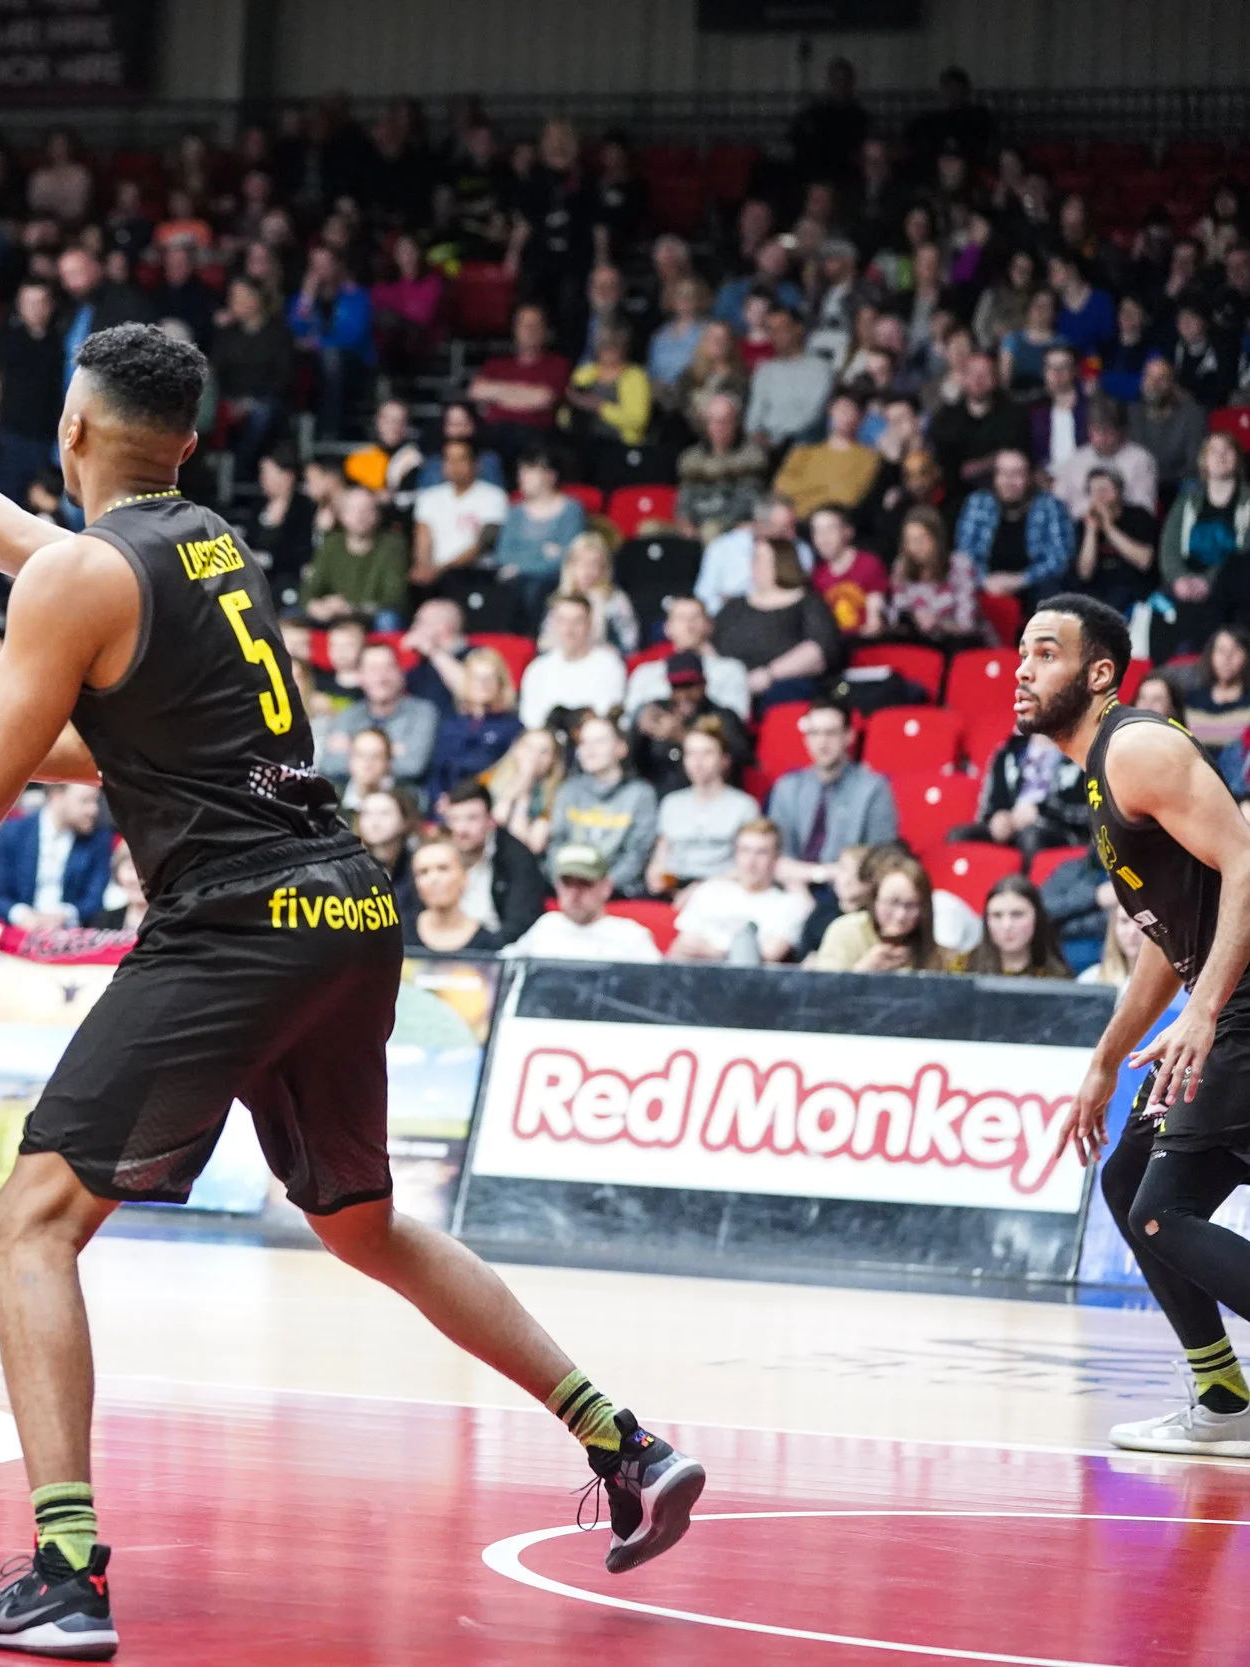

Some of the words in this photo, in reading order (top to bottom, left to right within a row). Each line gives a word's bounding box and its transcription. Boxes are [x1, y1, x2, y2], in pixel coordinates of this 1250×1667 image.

[218, 588, 293, 736] 5
[268, 885, 399, 933] fiveorsix
[512, 1048, 698, 1149] Red
[701, 1058, 1076, 1195] Monkey
